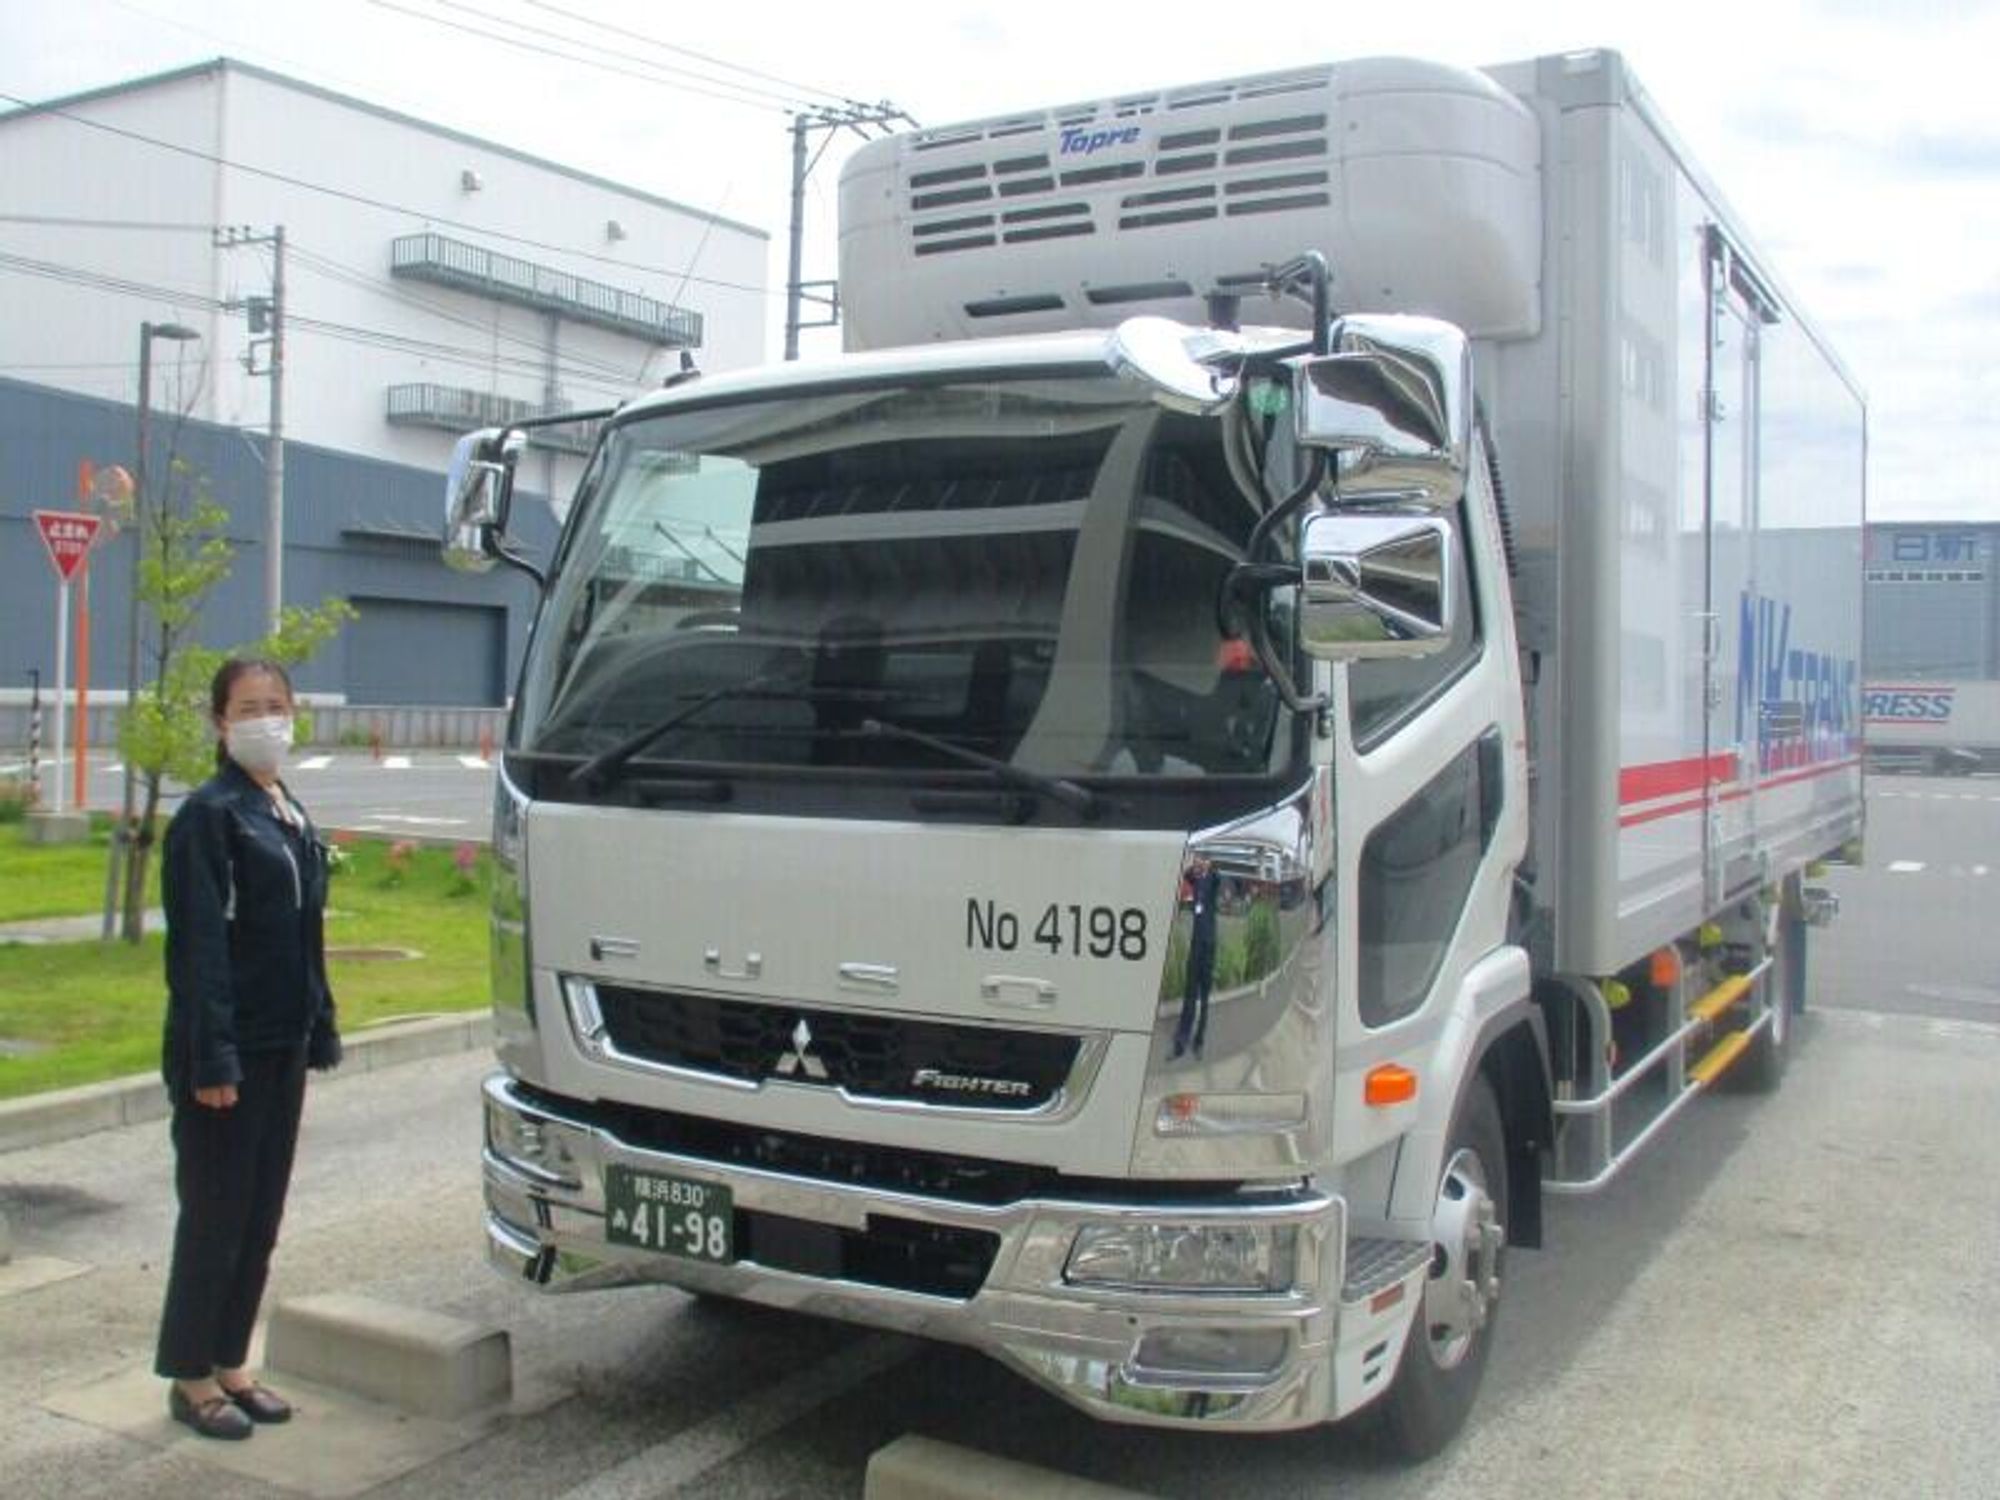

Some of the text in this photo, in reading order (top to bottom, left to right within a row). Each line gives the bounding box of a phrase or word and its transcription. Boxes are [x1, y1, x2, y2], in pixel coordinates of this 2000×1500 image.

[1035, 903, 1148, 961] 4198
[912, 1069, 1031, 1096] FIGHTER
[632, 1201, 726, 1259] 41-98
